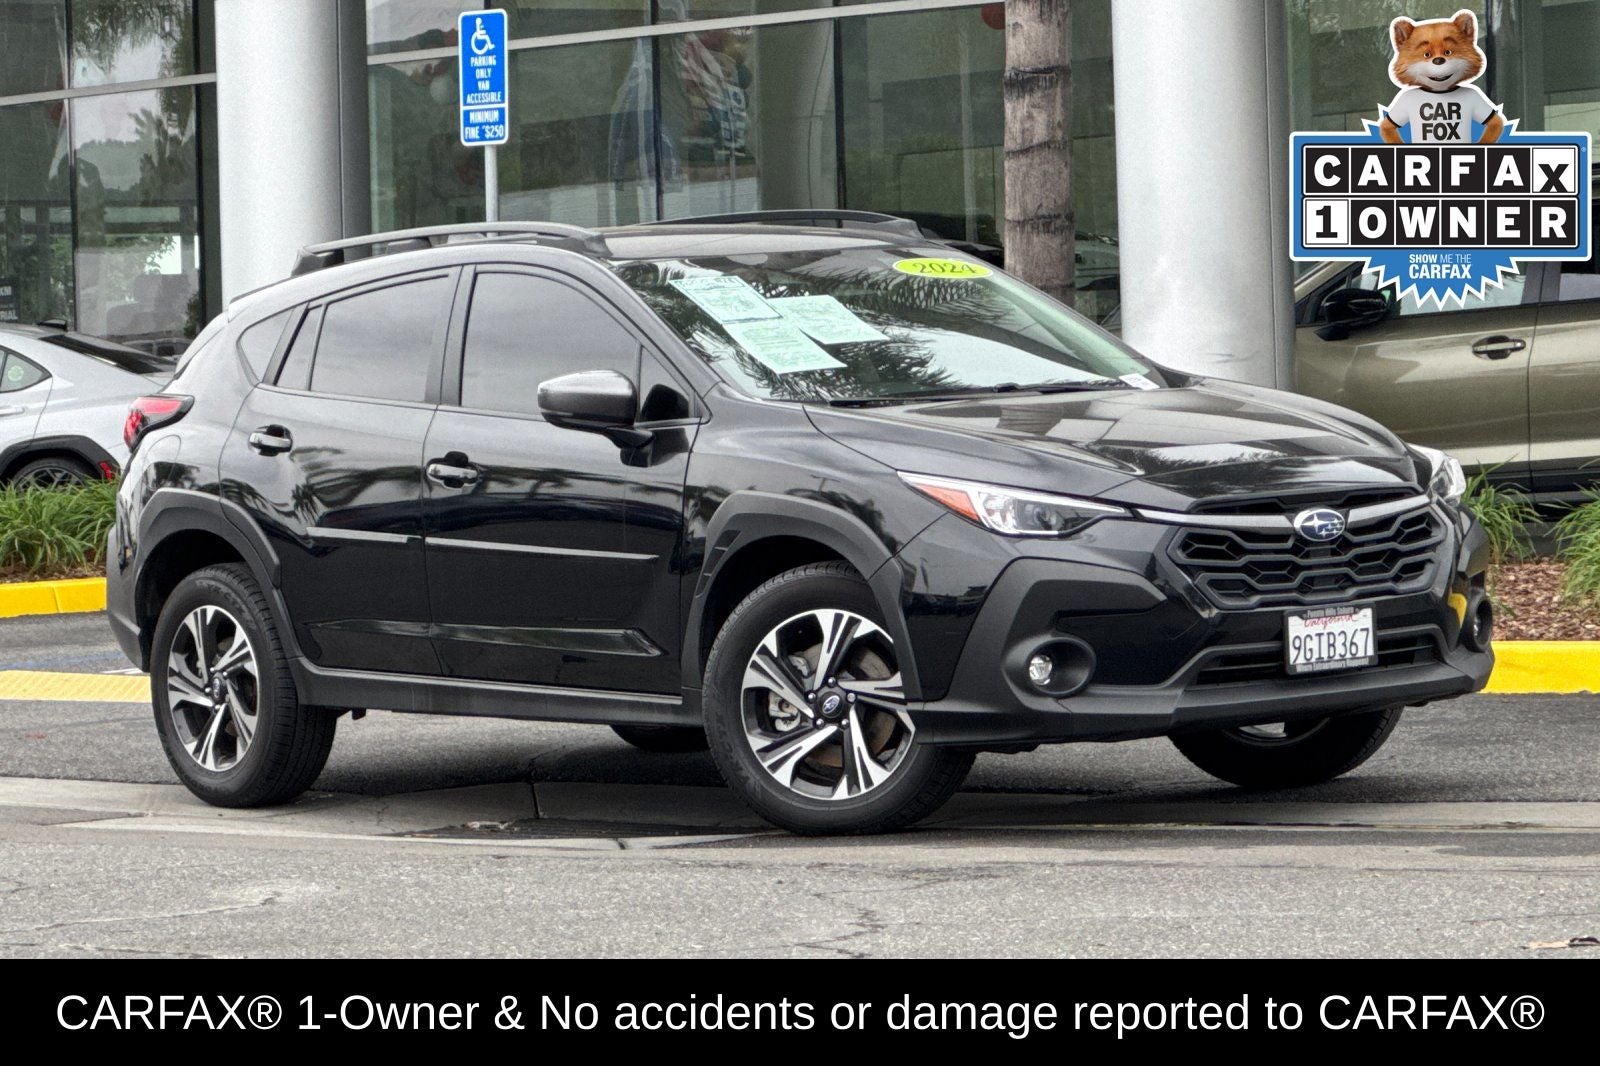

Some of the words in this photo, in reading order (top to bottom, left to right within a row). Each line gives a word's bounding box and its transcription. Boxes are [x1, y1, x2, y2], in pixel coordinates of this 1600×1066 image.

[470, 55, 497, 67] PARKING
[475, 68, 492, 79] ONLY
[477, 80, 490, 91] VAN
[466, 91, 502, 104] ACCESSIBLE
[469, 109, 499, 123] MINIMUM
[465, 126, 480, 139] FINE
[912, 262, 976, 273] 2024
[1292, 627, 1370, 664] 9GIB367
